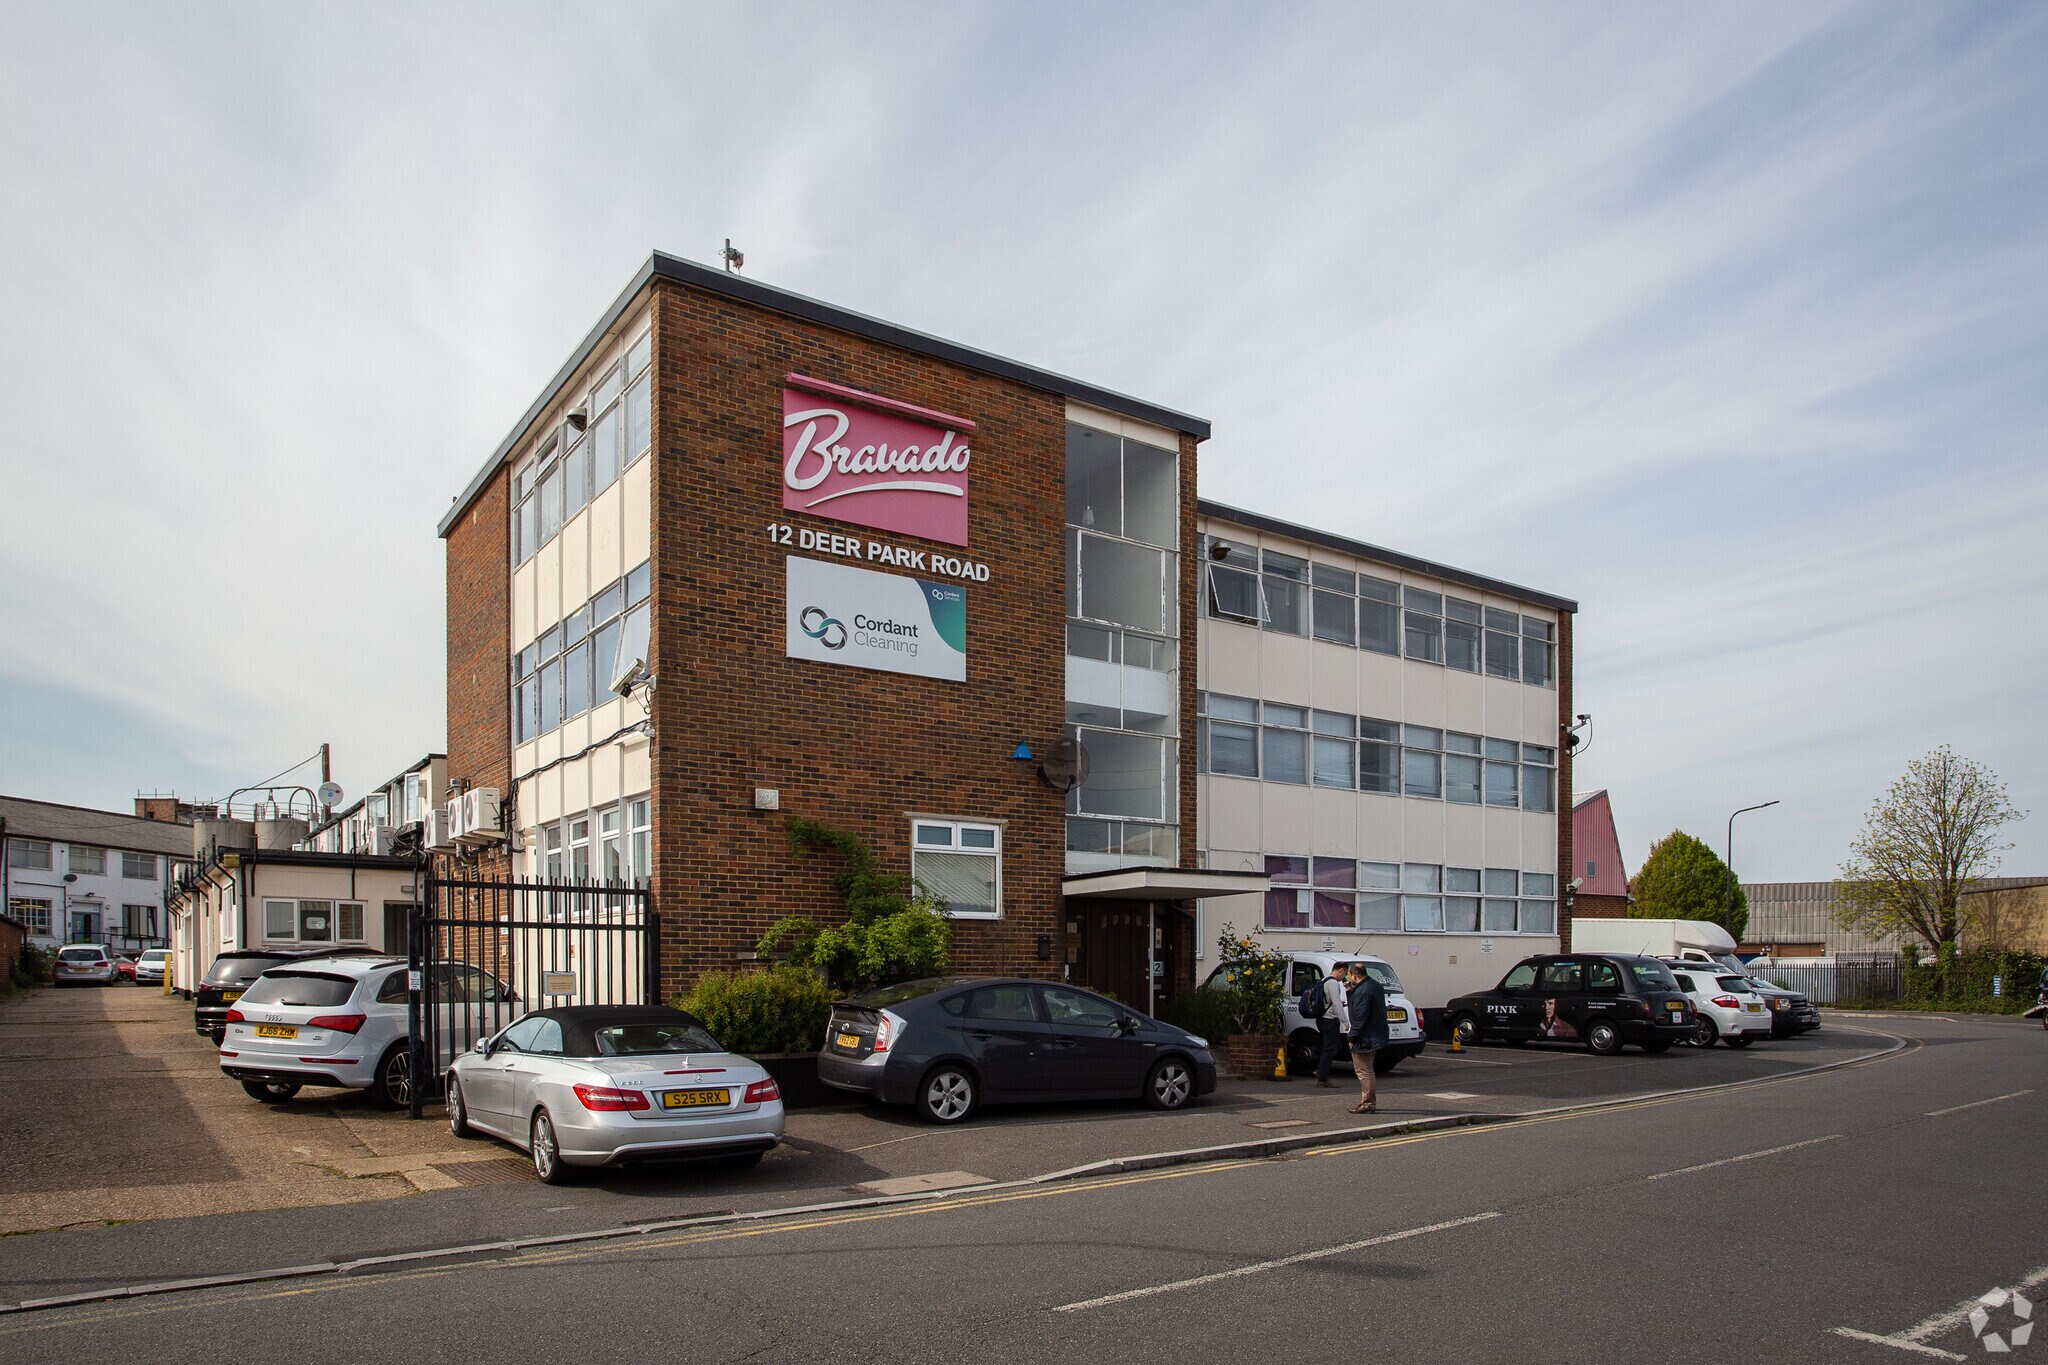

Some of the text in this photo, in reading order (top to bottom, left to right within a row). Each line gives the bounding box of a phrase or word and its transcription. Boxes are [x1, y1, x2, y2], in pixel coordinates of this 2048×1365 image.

[784, 408, 970, 491] Bravado
[767, 523, 990, 582] 12 DEER PARK ROAD
[854, 614, 918, 638] Cordant
[854, 631, 918, 657] Cleaning
[1487, 1005, 1517, 1014] PINK
[280, 1027, 296, 1037] ZHM
[673, 1091, 722, 1105] S25 SRX
